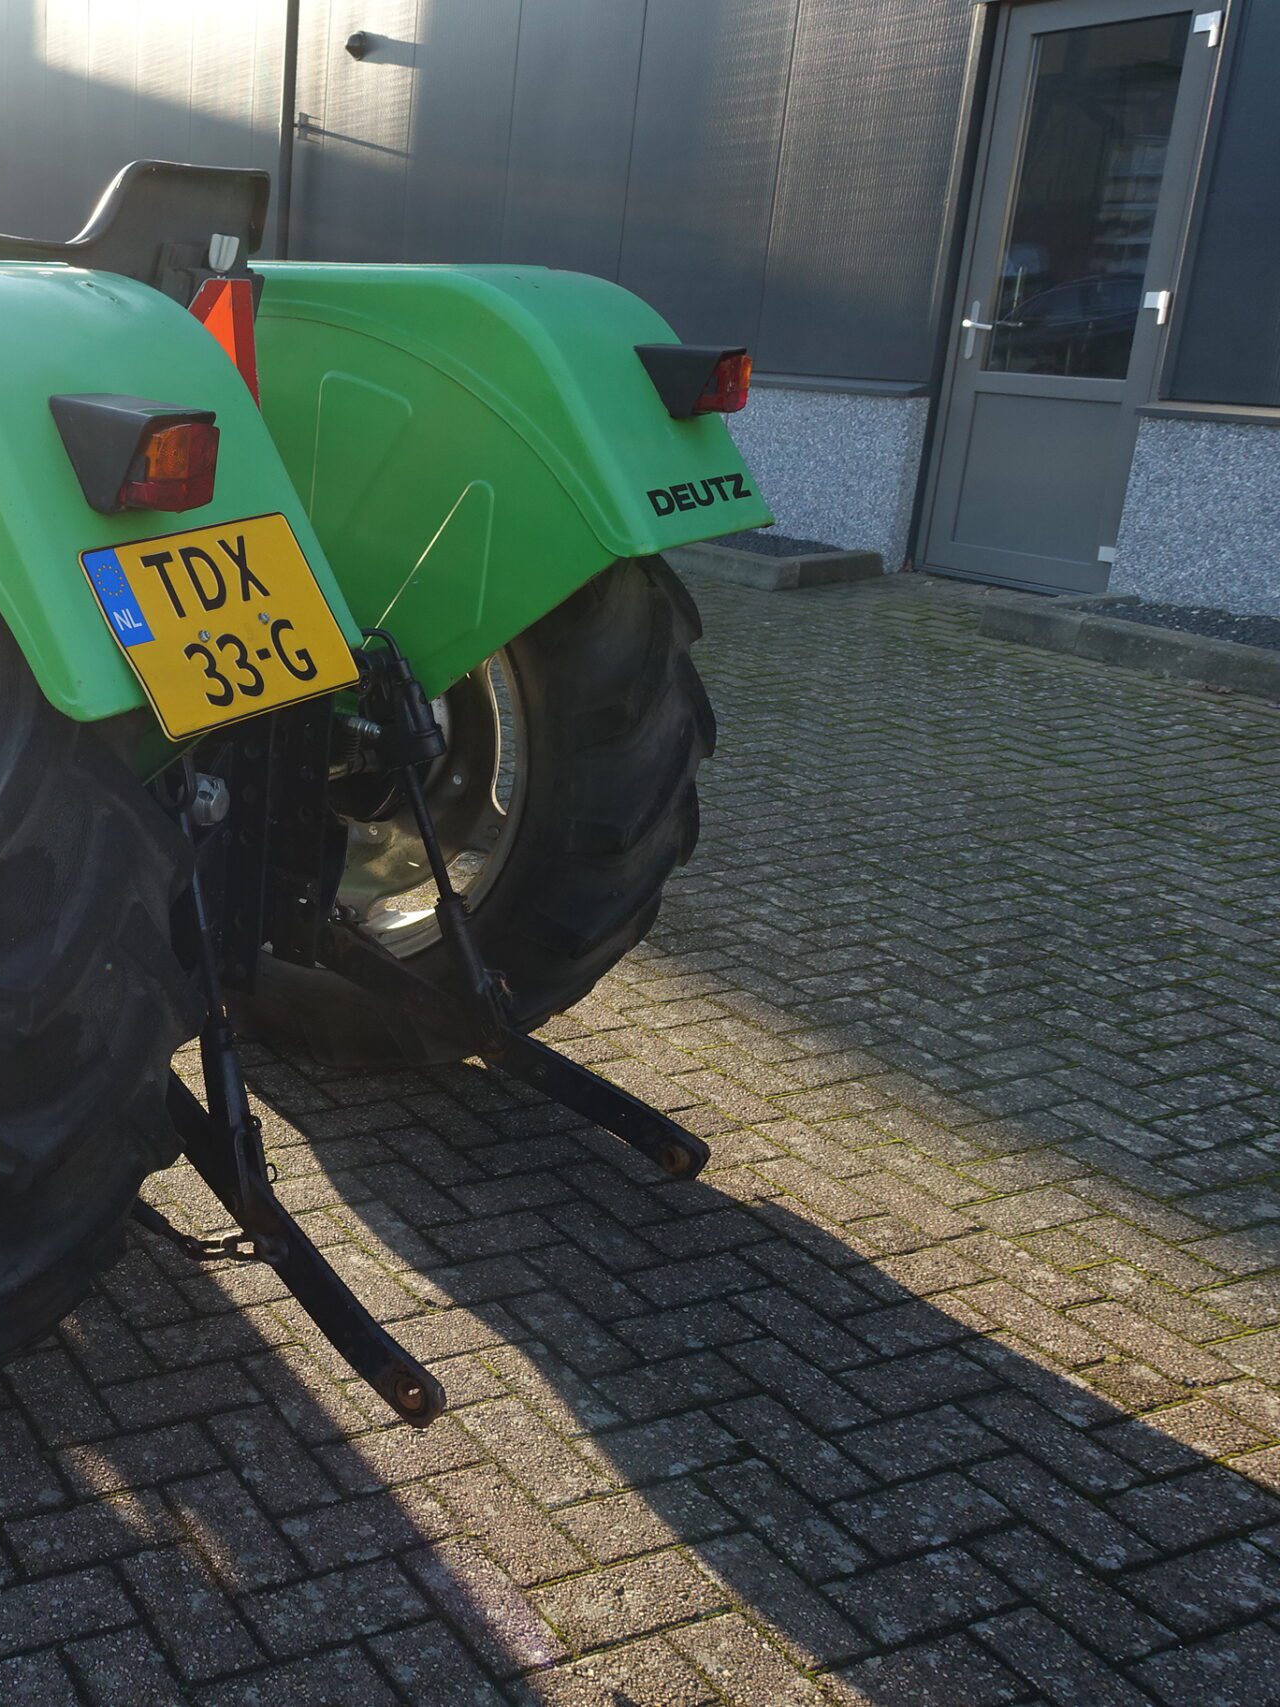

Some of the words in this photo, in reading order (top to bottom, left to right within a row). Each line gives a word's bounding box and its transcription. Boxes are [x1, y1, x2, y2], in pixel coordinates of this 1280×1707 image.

[646, 472, 752, 517] DEUTZ
[140, 535, 271, 618] TDX
[113, 608, 142, 631] NL
[183, 619, 318, 707] 33-G
